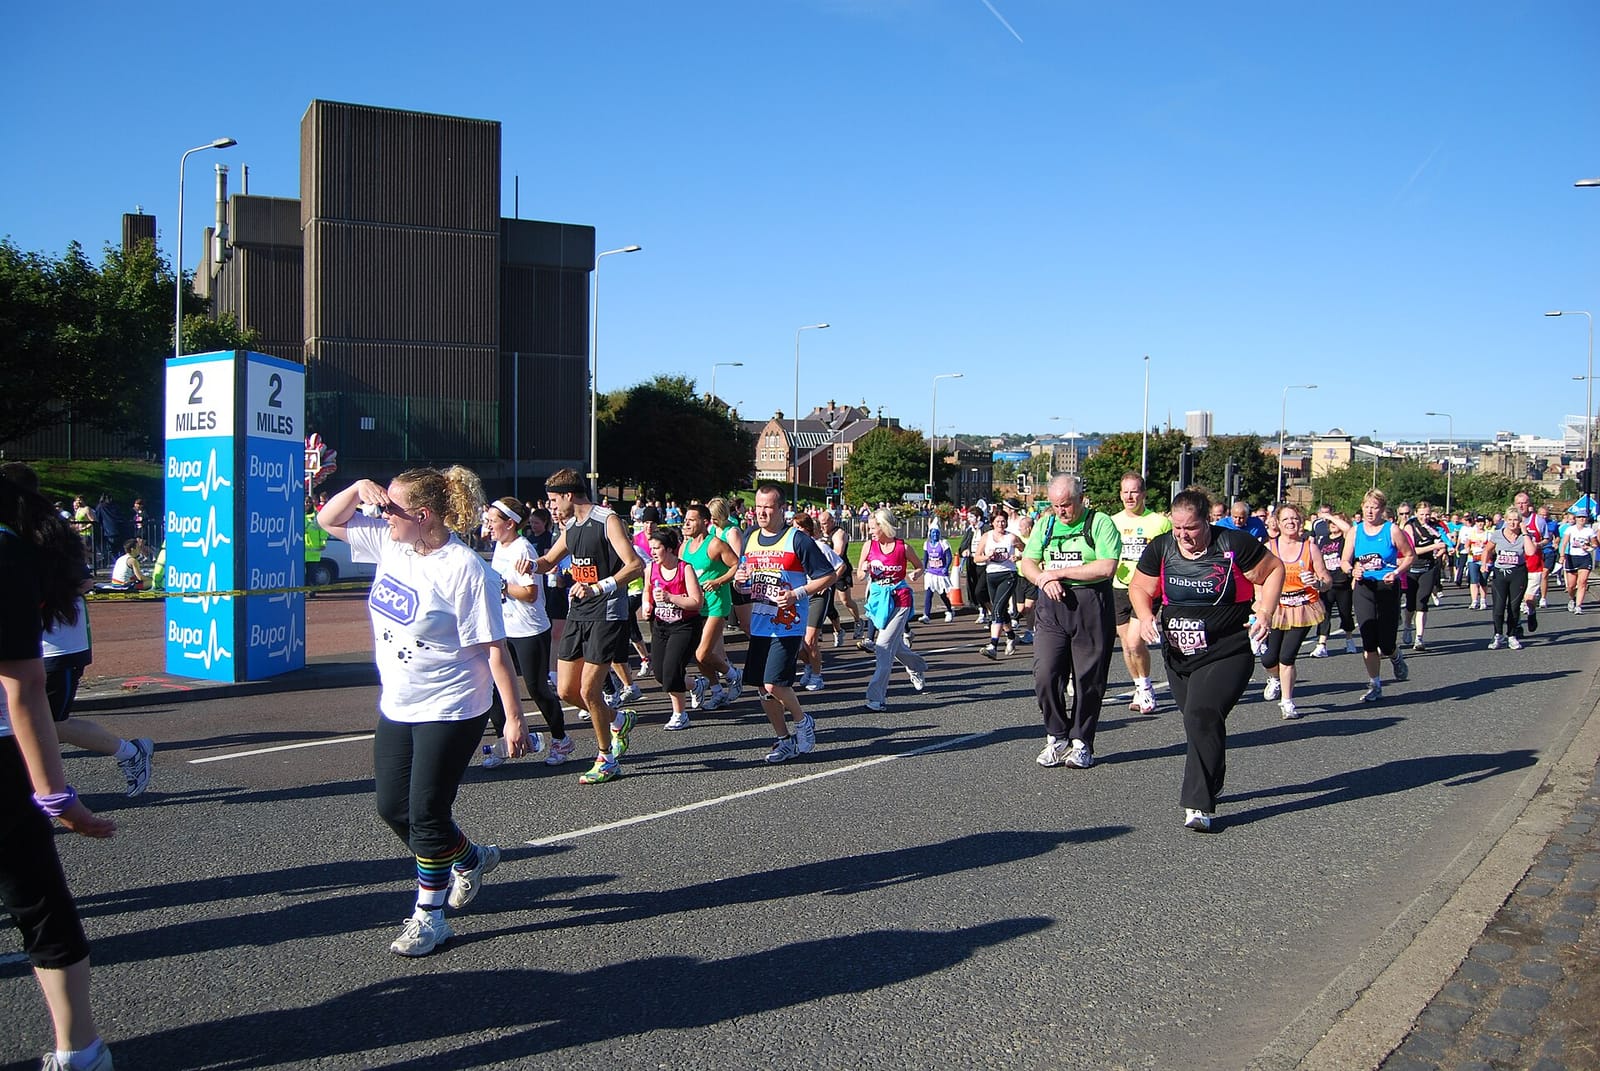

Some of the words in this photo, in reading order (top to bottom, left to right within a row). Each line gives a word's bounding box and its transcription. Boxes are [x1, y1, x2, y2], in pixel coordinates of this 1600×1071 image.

[188, 370, 203, 404] 2
[269, 373, 282, 408] 2
[175, 410, 216, 431] MILES
[257, 412, 293, 435] MILES
[168, 456, 202, 483] Bupa
[250, 455, 284, 483] Bupa
[168, 511, 202, 538] Bupa
[250, 512, 285, 539] Bupa
[572, 554, 591, 566] upa
[748, 550, 785, 558] CHILDREN
[1053, 550, 1079, 562] Bupa
[168, 565, 202, 592] Bupa
[250, 567, 286, 590] Bupa
[755, 575, 778, 585] Bupa
[1169, 577, 1214, 588] Diabetes
[373, 583, 409, 616] RSPCA
[168, 620, 203, 649] Bupa
[1168, 617, 1200, 632] Bupa
[250, 625, 286, 649] Bupa
